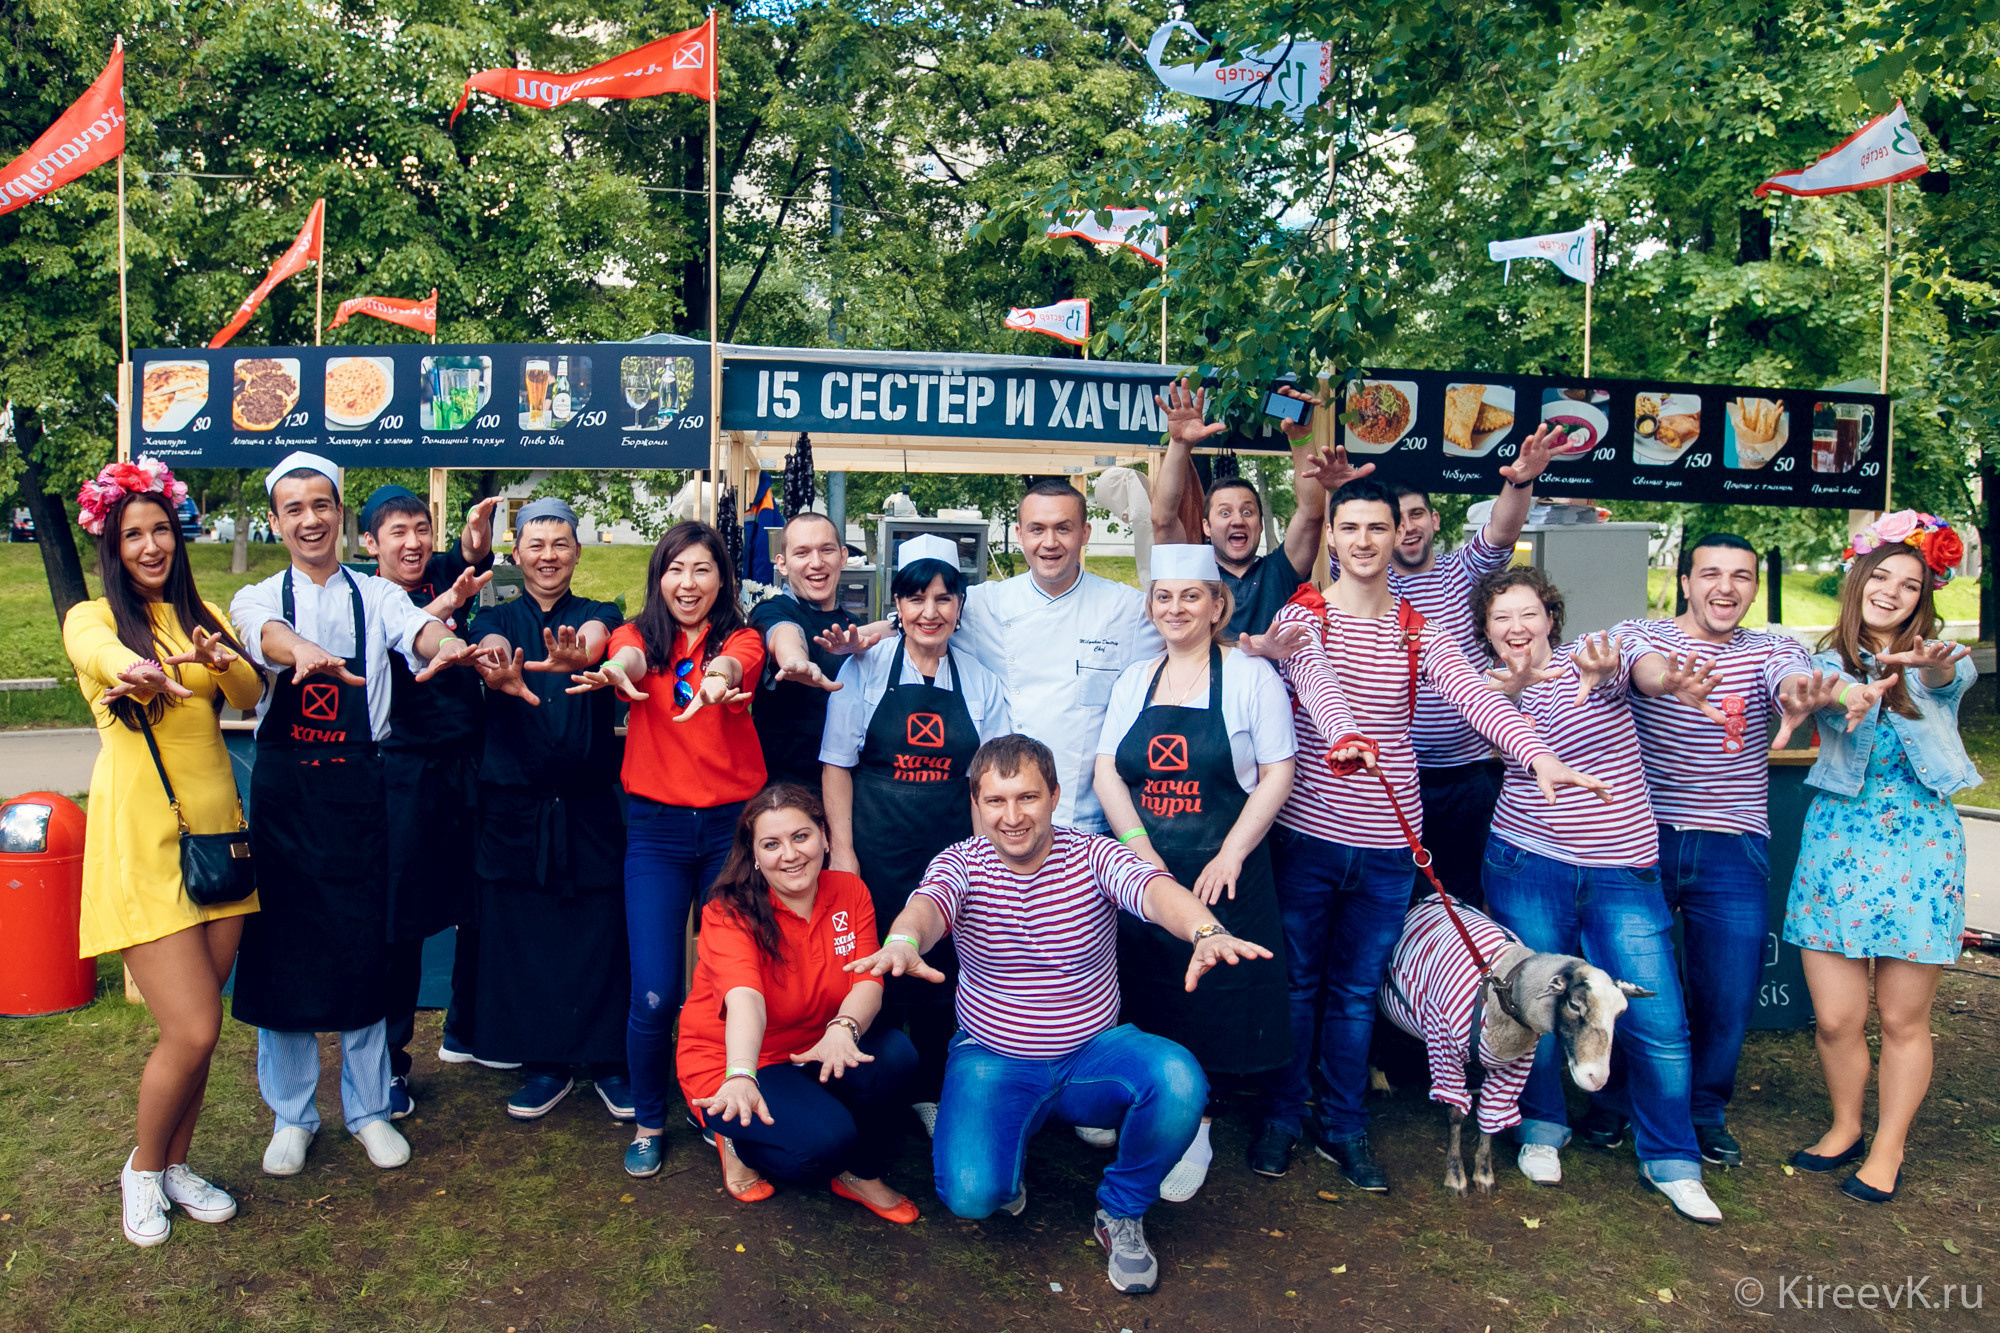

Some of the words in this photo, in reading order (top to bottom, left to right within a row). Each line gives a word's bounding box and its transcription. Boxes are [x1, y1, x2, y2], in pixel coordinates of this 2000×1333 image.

[757, 370, 801, 419] 15
[820, 366, 995, 425] СЕСТЁР
[1005, 378, 1036, 426] И
[192, 416, 212, 432] 80
[285, 411, 309, 428] 120
[379, 415, 404, 431] 100
[475, 414, 500, 430] 100
[576, 410, 607, 428] 150
[678, 415, 704, 430] 150
[143, 437, 187, 448] Хачапури
[326, 436, 372, 447] Хачапури
[421, 435, 469, 445] Домашний
[472, 438, 506, 447] тархун
[520, 435, 546, 447] Пиво
[621, 436, 669, 449] Боржоми
[1400, 437, 1427, 450] 200
[1497, 443, 1516, 457] 60
[1592, 447, 1616, 461] 100
[1684, 452, 1712, 469] 150
[1773, 456, 1795, 472] 50
[1859, 461, 1880, 477] 50
[893, 753, 952, 771] хача
[1144, 778, 1201, 795] хача
[1140, 793, 1202, 818] пури
